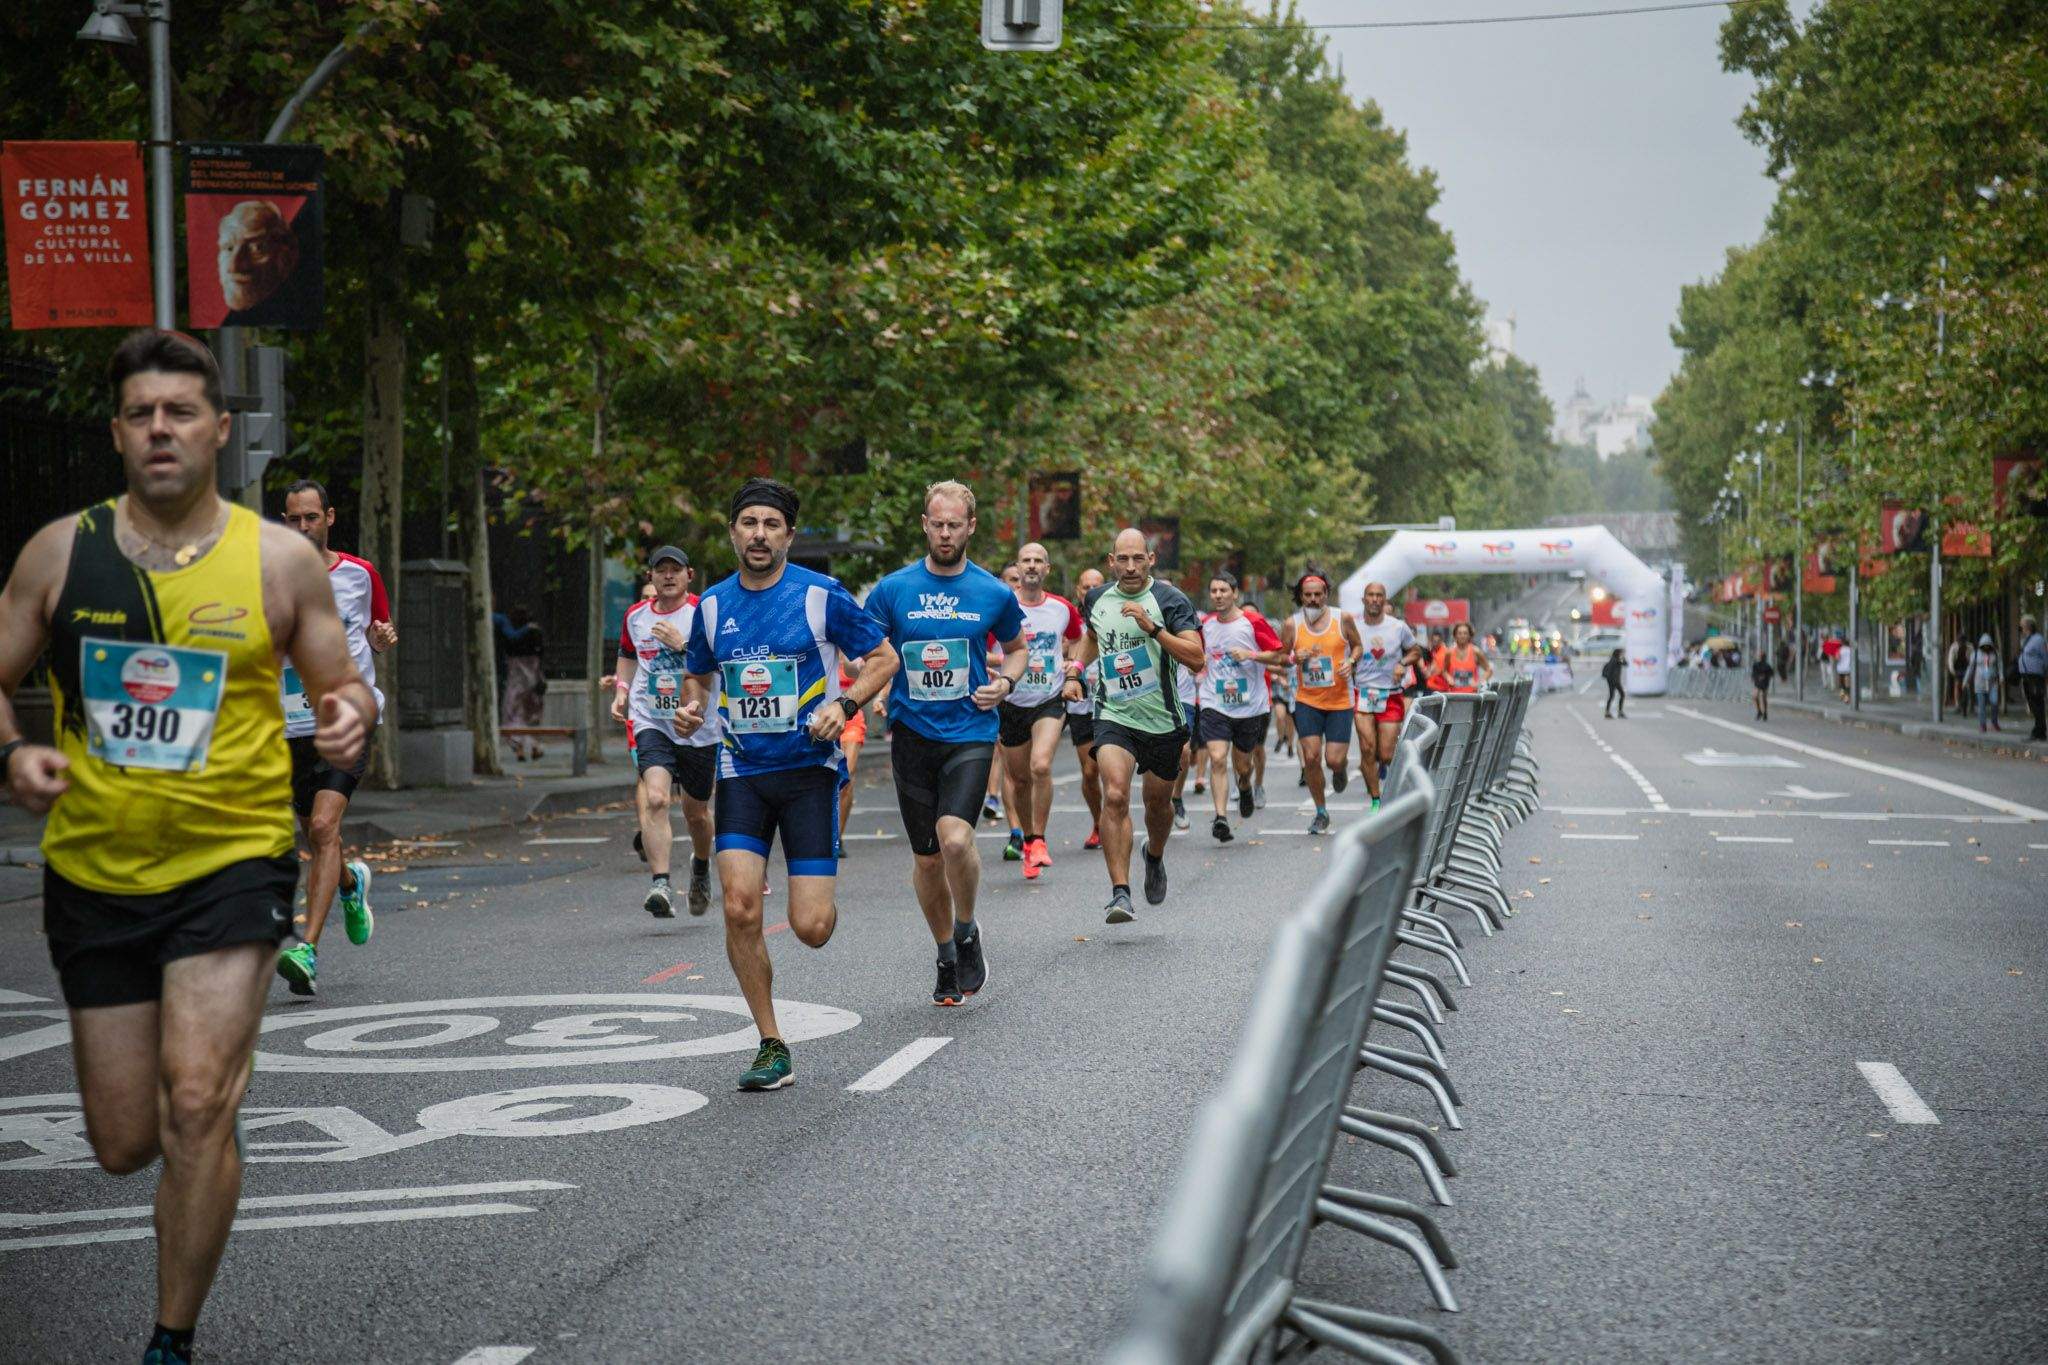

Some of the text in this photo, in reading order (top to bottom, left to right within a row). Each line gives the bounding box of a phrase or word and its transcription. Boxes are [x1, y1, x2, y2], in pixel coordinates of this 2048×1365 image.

[19, 173, 128, 197] FERNÁN
[20, 197, 130, 220] GÓMEZ
[43, 224, 110, 236] CENTRO
[35, 239, 121, 250] CULTURAL
[24, 252, 133, 265] DE LA VILLA
[731, 645, 770, 658] CLUB
[922, 670, 954, 688] 402
[1027, 673, 1047, 684] 386
[1119, 673, 1142, 690] 415
[655, 696, 680, 709] 385
[737, 696, 780, 718] 1231
[111, 704, 180, 743] 390
[304, 1012, 699, 1051] 30
